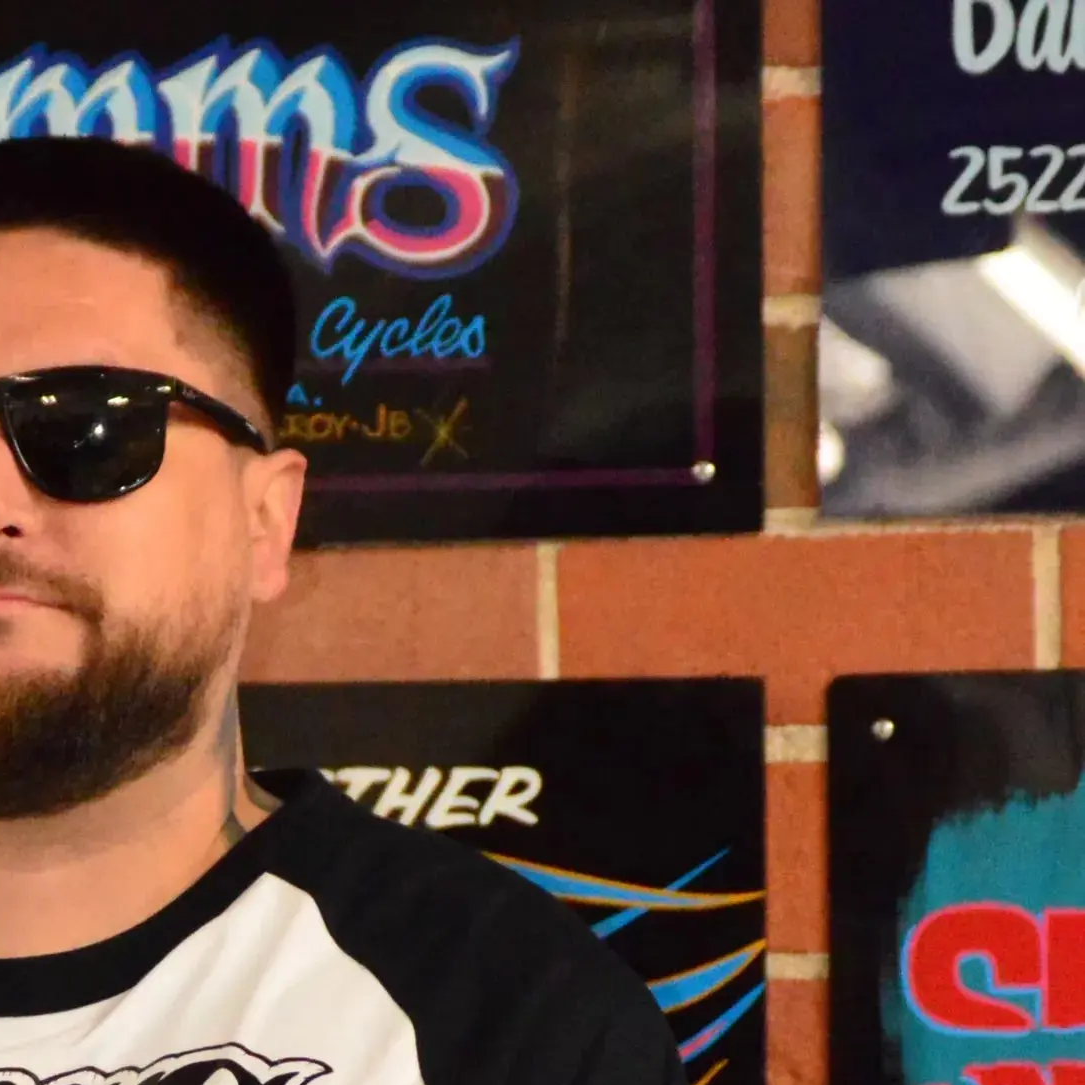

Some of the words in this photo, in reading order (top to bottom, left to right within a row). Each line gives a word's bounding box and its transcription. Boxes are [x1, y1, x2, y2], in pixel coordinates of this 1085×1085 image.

[940, 143, 1085, 215] 2522
[310, 293, 487, 386] Cycles
[317, 764, 543, 829] THER
